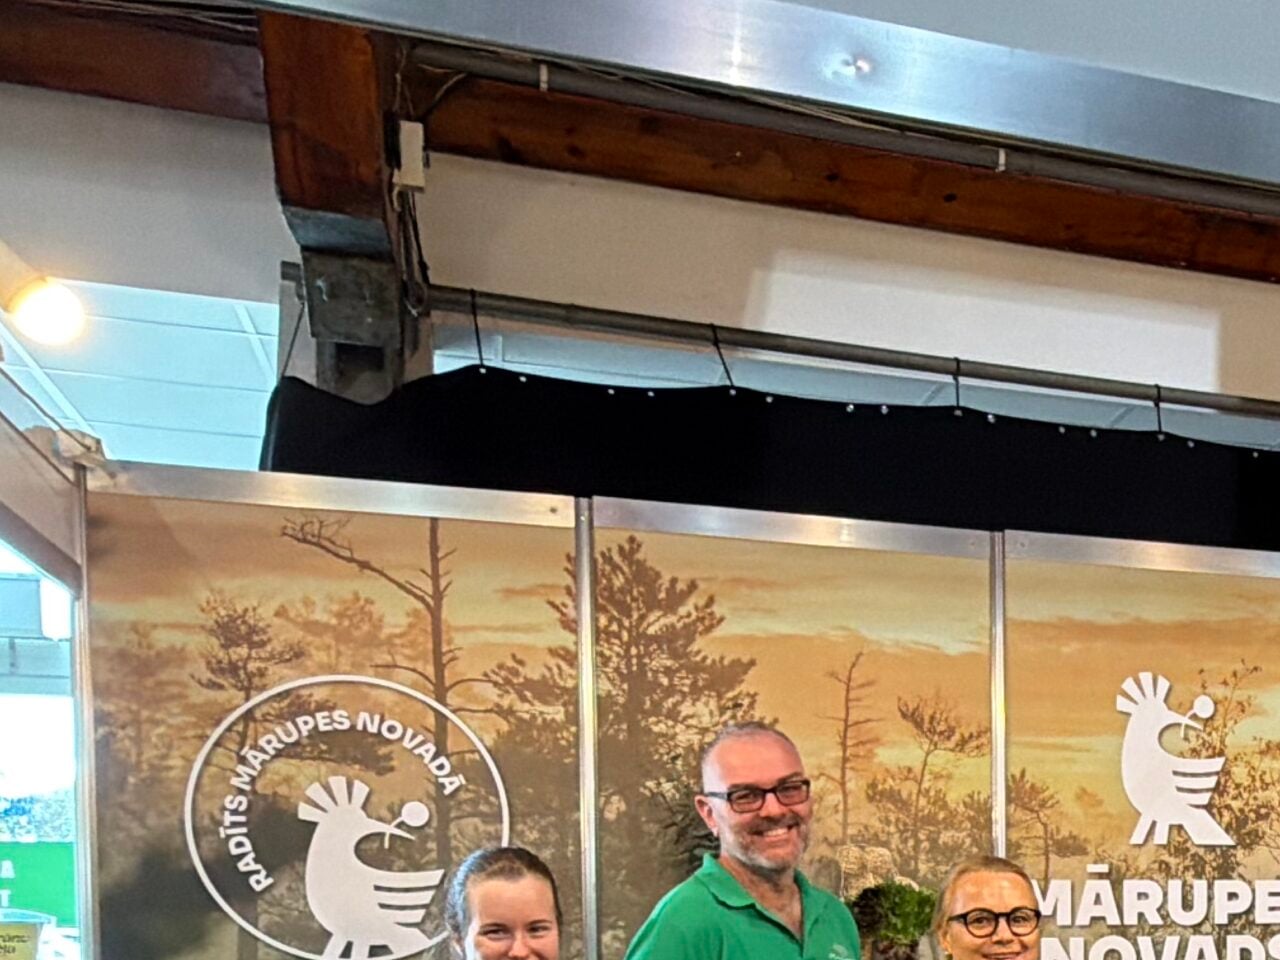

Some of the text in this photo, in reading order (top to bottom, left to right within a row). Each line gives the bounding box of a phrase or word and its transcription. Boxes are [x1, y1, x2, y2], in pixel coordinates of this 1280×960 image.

[219, 709, 466, 892] RADĪTS MĀRUPES NOVADĀ
